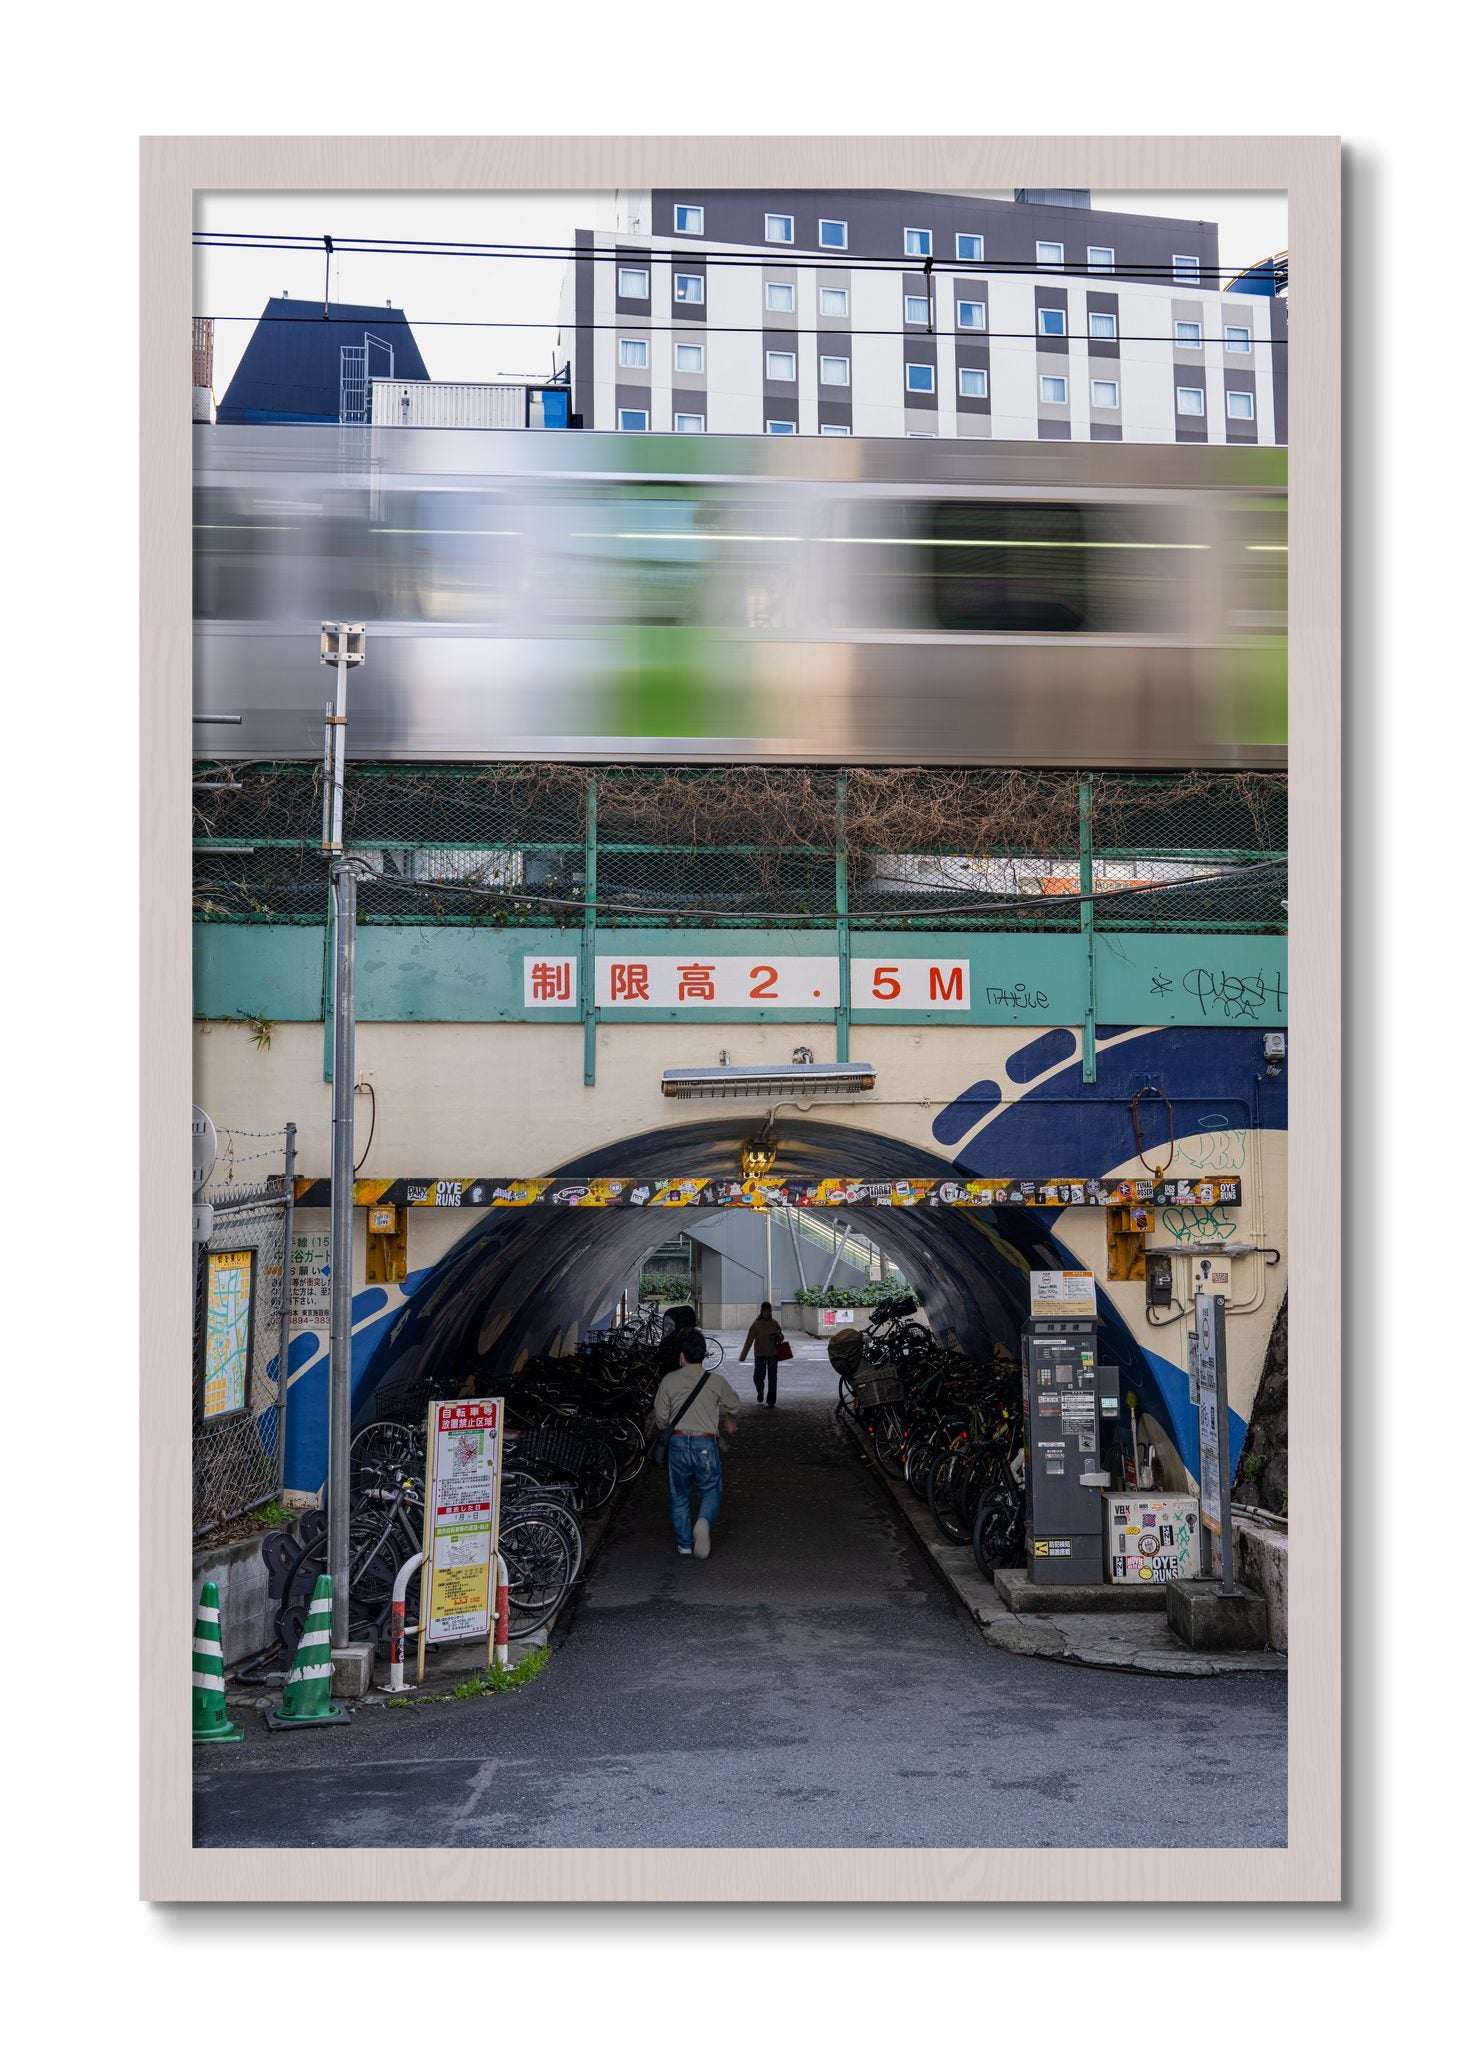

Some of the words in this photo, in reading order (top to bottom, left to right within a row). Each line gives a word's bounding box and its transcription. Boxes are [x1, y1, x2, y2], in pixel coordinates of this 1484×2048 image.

[531, 962, 964, 1001] 制限高2.5M
[437, 1181, 462, 1194] OYE
[1220, 1183, 1236, 1192] OYE
[436, 1194, 461, 1207] RUNS
[1220, 1192, 1237, 1200] RUNS
[442, 1417, 493, 1430] 放置禁止区域
[1152, 1556, 1177, 1569] OYE
[1153, 1569, 1179, 1582] RUNS
